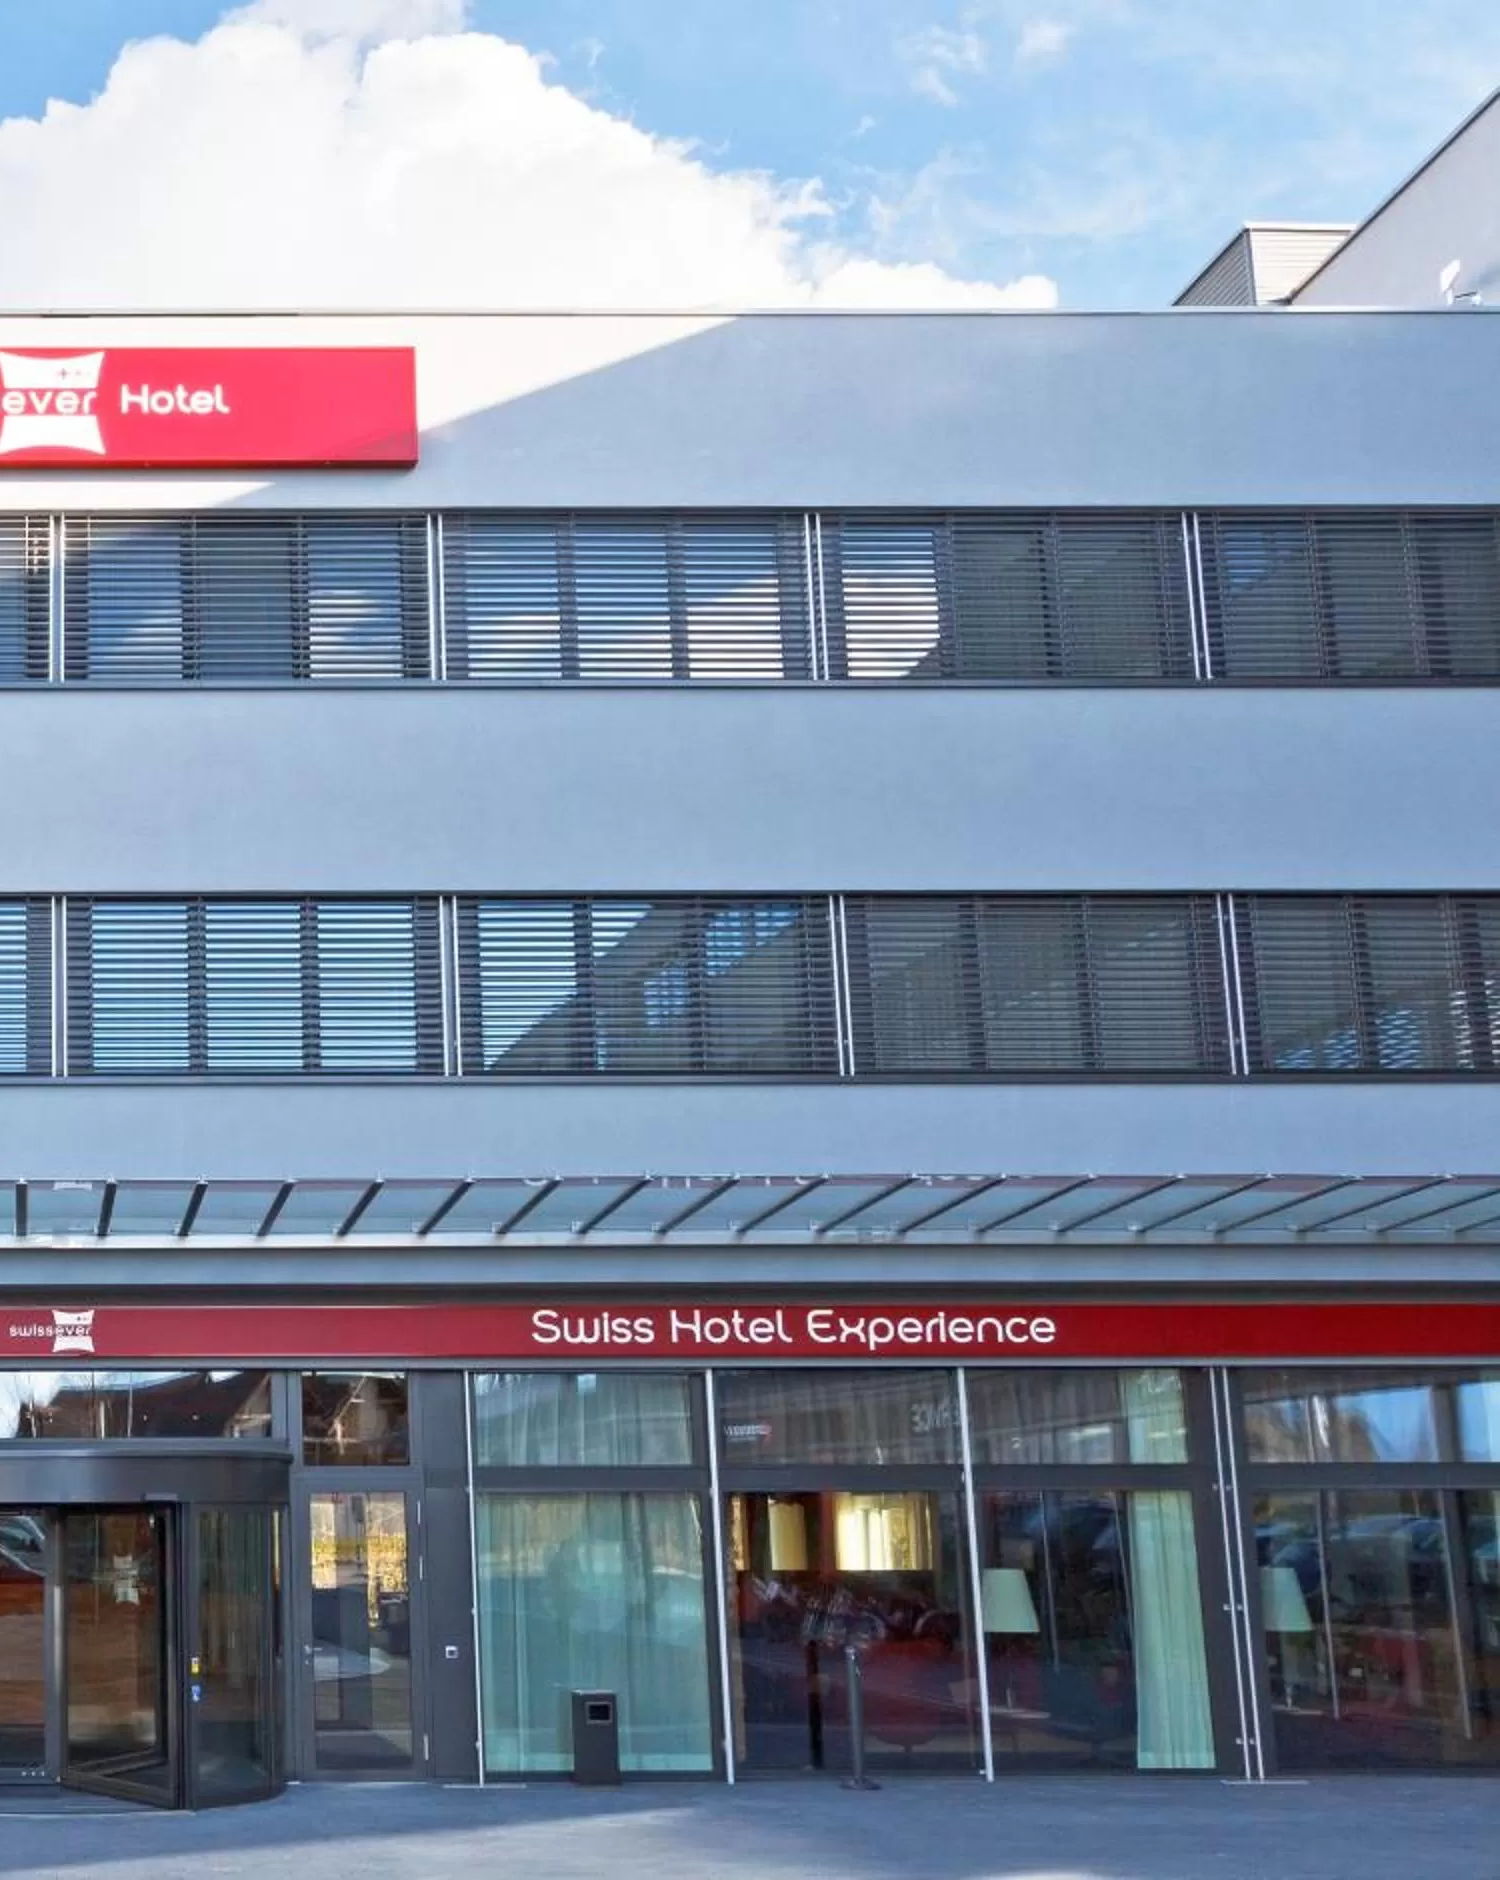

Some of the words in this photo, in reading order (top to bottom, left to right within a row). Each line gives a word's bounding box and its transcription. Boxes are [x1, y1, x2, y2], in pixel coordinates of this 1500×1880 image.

[120, 384, 230, 415] Hotel
[9, 1324, 92, 1337] swissever
[531, 1309, 655, 1344] Swiss
[670, 1309, 793, 1344] Hotel
[806, 1309, 1056, 1351] Experience
